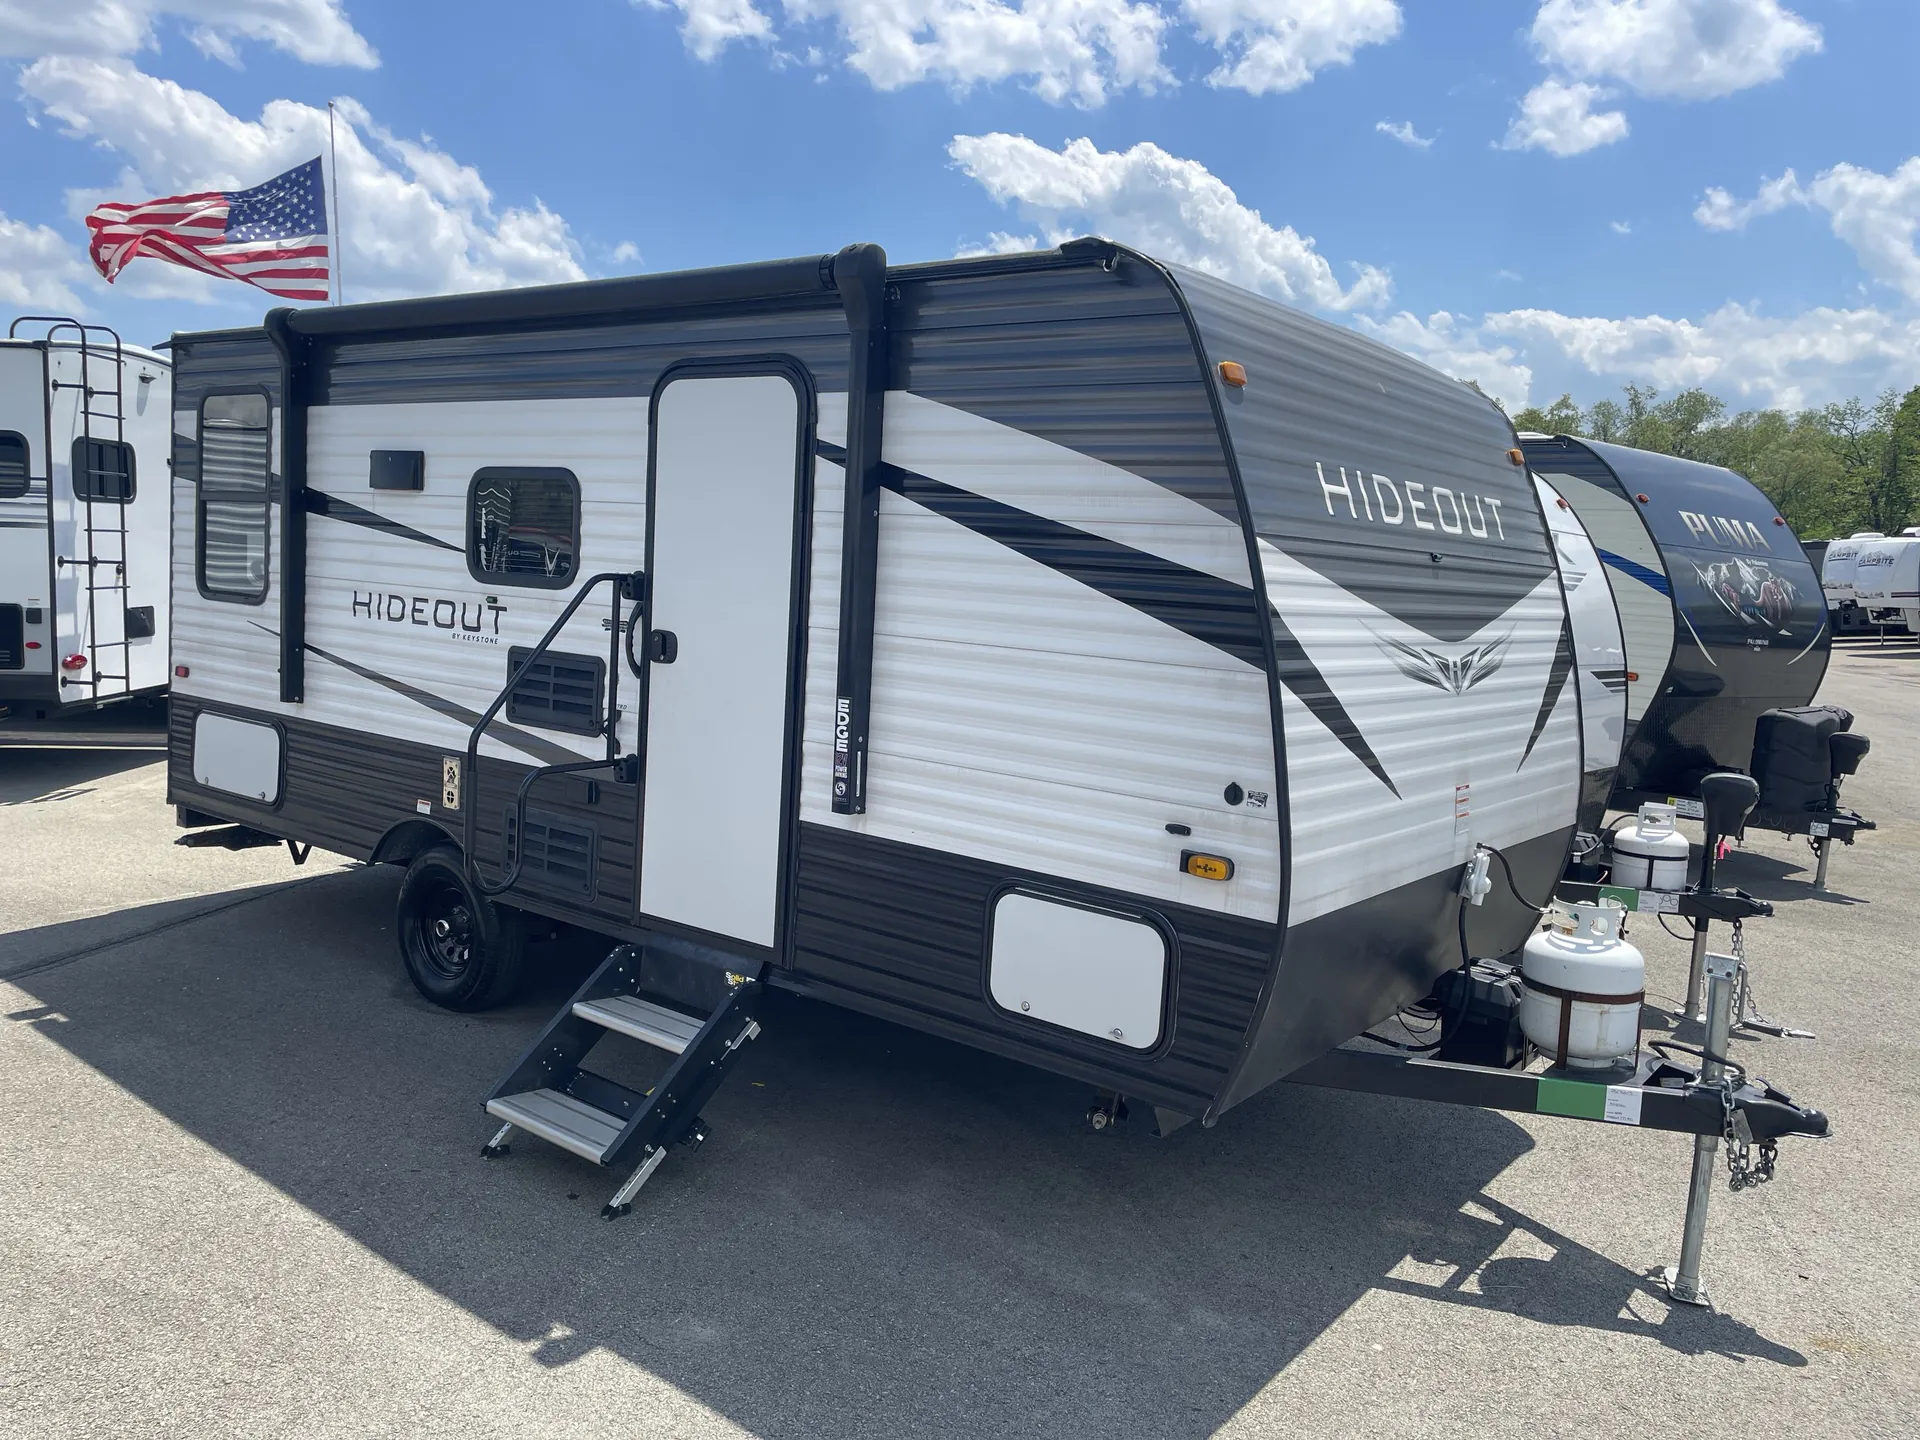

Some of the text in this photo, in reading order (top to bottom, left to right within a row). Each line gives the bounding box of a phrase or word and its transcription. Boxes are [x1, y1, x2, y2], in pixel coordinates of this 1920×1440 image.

[1315, 461, 1505, 541] HIDEOUT
[1677, 510, 1773, 553] PUMA
[1828, 552, 1859, 560] CAMPSIT
[1858, 557, 1895, 566] CAMPSITE
[352, 590, 508, 635] HIDEOUT
[452, 632, 499, 645] BY KEYSTONE
[836, 698, 850, 753] EDGE
